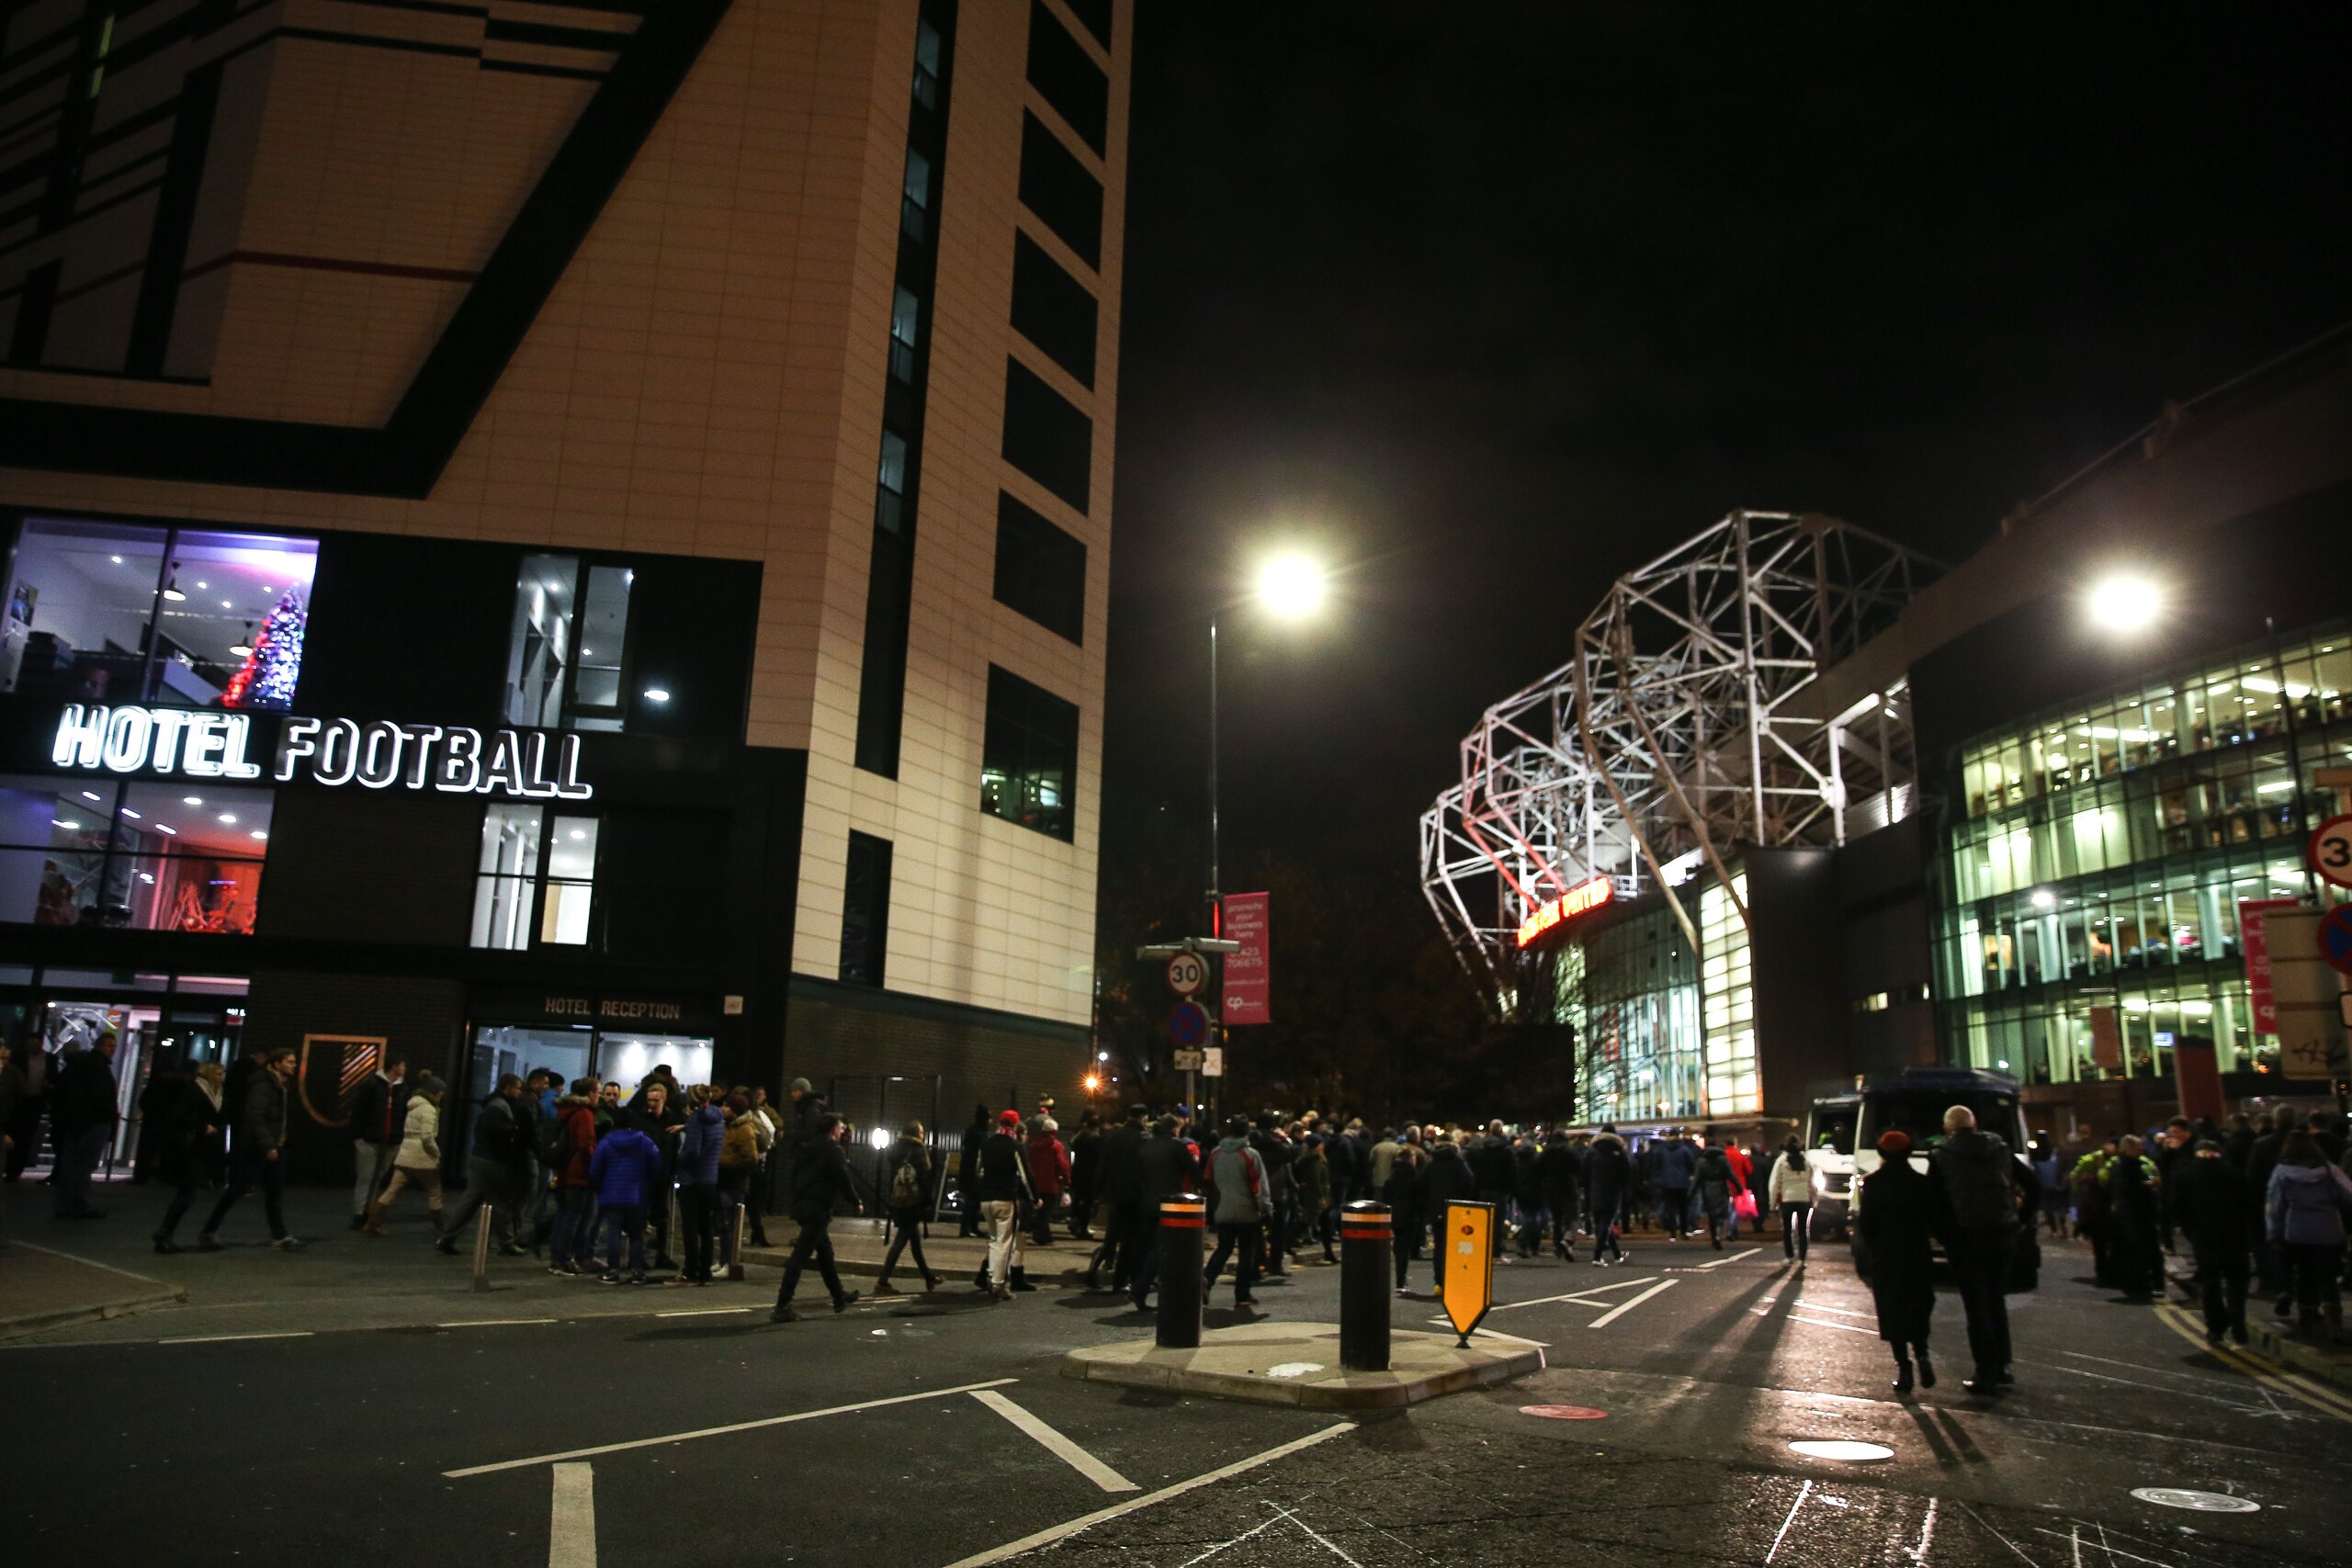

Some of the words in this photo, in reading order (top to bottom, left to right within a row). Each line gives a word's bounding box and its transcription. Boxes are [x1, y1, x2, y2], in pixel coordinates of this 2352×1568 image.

[51, 703, 261, 779] HOTEL
[275, 716, 594, 800] FOOTBALL
[2324, 837, 2350, 867] 3
[1172, 964, 1198, 983] 30
[545, 997, 591, 1016] HOTEL
[601, 999, 680, 1020] RECEPTION
